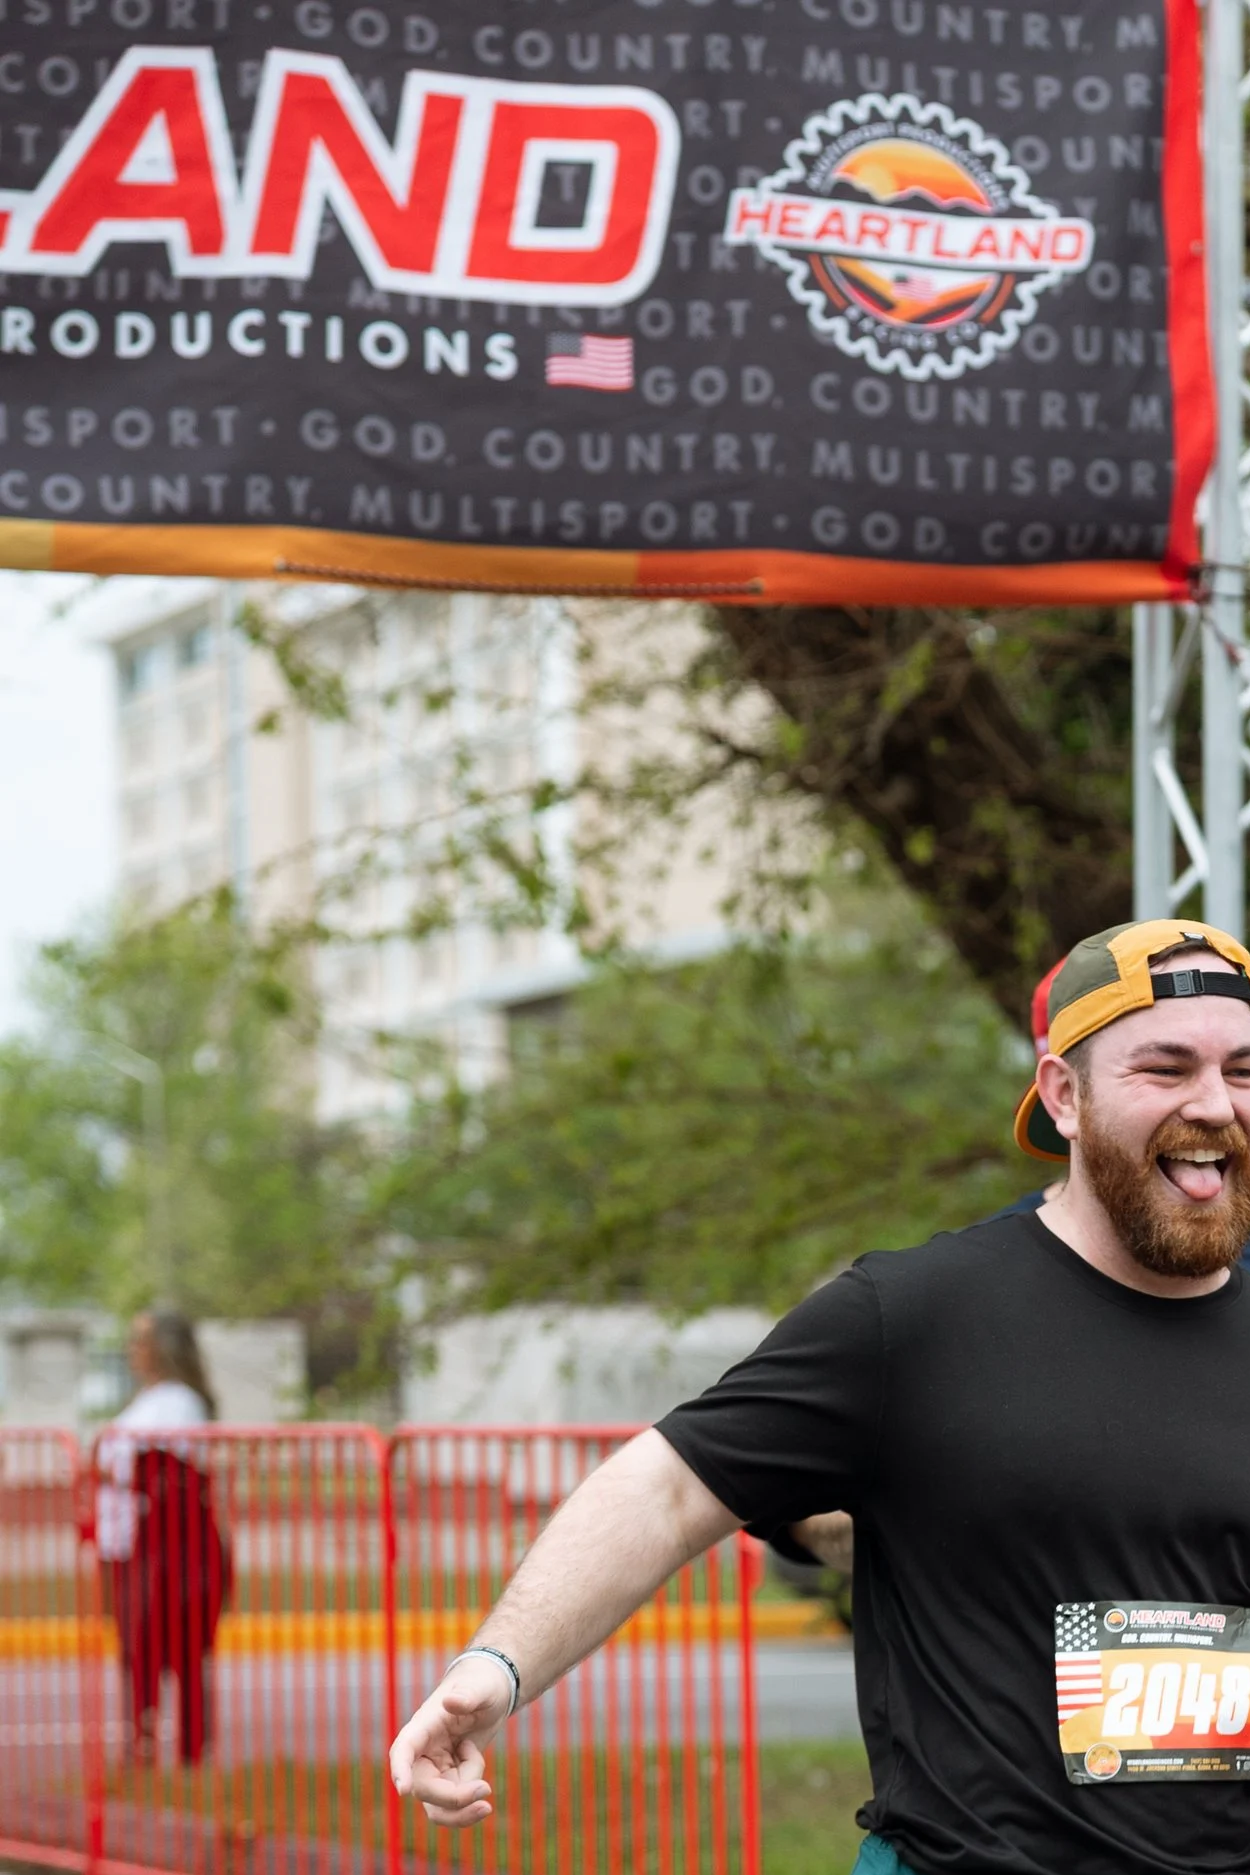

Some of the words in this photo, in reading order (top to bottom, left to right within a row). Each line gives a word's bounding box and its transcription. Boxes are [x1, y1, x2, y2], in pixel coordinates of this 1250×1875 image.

[0, 0, 231, 29] SPORT
[802, 45, 1165, 114] MULTISPOR
[0, 45, 682, 306] AND
[733, 196, 1086, 264] HEARTLAND
[0, 304, 519, 381] RODUCTIONS
[811, 439, 1174, 499] MULTISPOR
[349, 484, 754, 542] MULTISPORT
[1129, 1609, 1227, 1630] HEARTLAND
